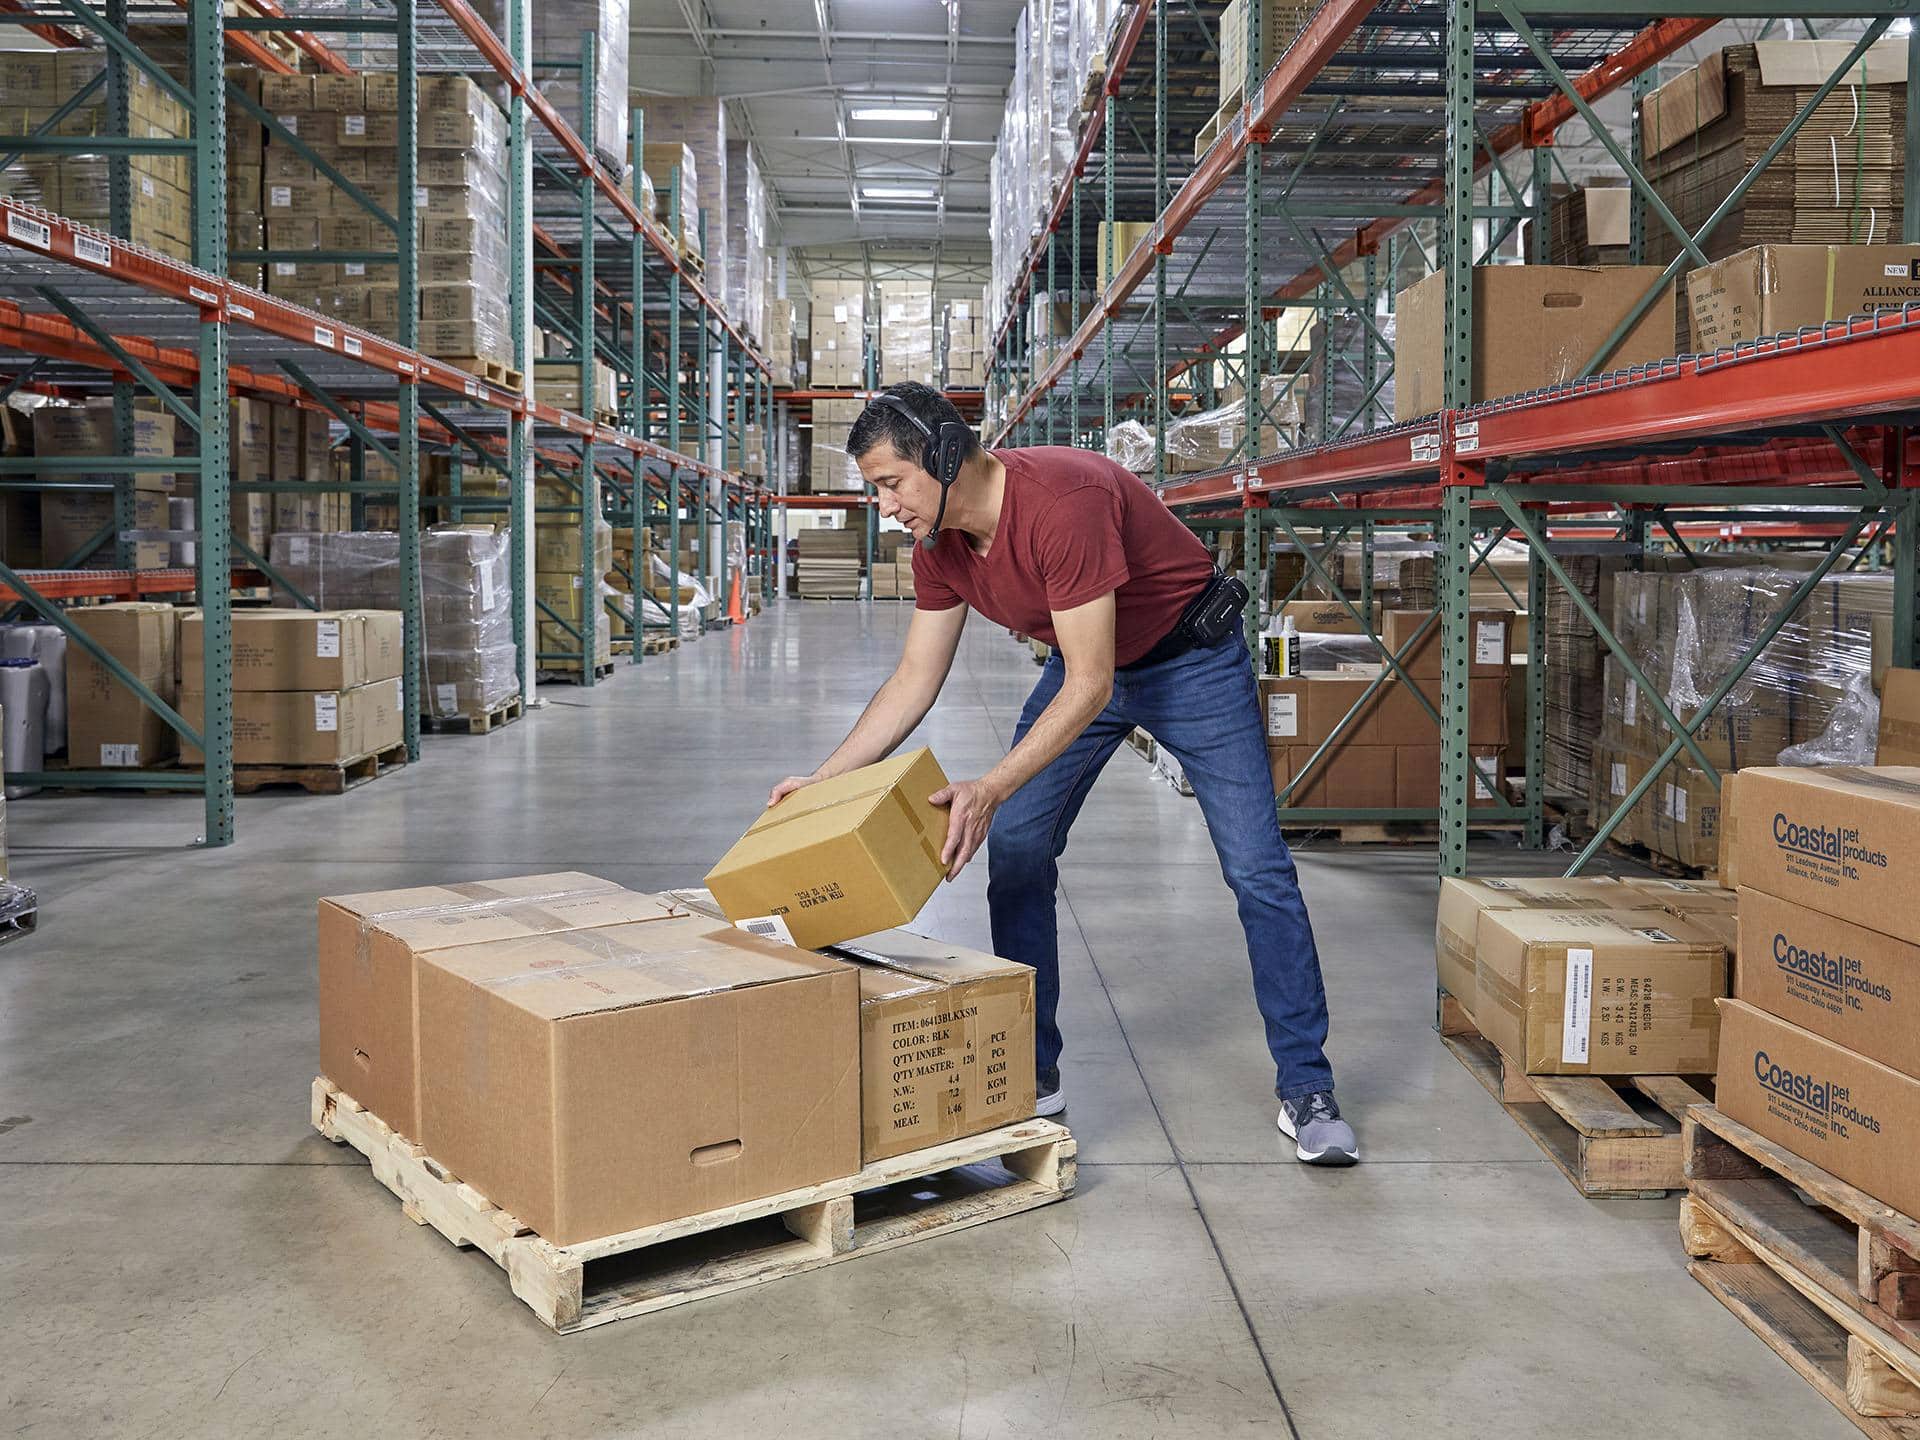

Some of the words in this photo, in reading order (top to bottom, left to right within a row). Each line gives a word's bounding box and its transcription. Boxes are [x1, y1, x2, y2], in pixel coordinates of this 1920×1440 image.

[1887, 266, 1906, 274] NEW
[1862, 286, 1920, 297] ALLIANCE
[1773, 812, 1841, 858] Coastal
[1842, 828, 1859, 844] pet
[1842, 845, 1888, 868] products
[1842, 862, 1860, 880] inc.
[1773, 933, 1843, 987] Coastal
[1844, 958, 1862, 974] pet
[1844, 975, 1892, 1002] products
[1845, 990, 1864, 1012] inc.
[892, 1020, 919, 1034] ITEM:
[920, 1006, 978, 1027] 06413BLKXSM
[892, 1033, 930, 1050] COLOR:
[932, 1029, 951, 1041] BLK
[892, 1053, 915, 1067] Q'TY
[916, 1046, 946, 1061] INNER:
[966, 1040, 972, 1049] 6
[991, 1031, 1007, 1043] PCE
[1601, 1031, 1610, 1047] KGS
[1615, 1031, 1624, 1047] KGS
[892, 1069, 915, 1083] Q'TY
[916, 1060, 955, 1077] MASTER:
[962, 1054, 975, 1065] 120
[892, 1084, 915, 1098] N.W.:
[948, 1073, 960, 1084] 4.4
[986, 1061, 1007, 1075] KGM
[1754, 1050, 1830, 1112] Coastal
[1831, 1084, 1850, 1103] pet
[893, 1100, 916, 1114] G.W.:
[986, 1076, 1007, 1090] KGM
[947, 1102, 962, 1115] 1.46
[985, 1091, 1008, 1106] CUFT
[1830, 1116, 1850, 1140] inc.
[1831, 1100, 1881, 1134] products
